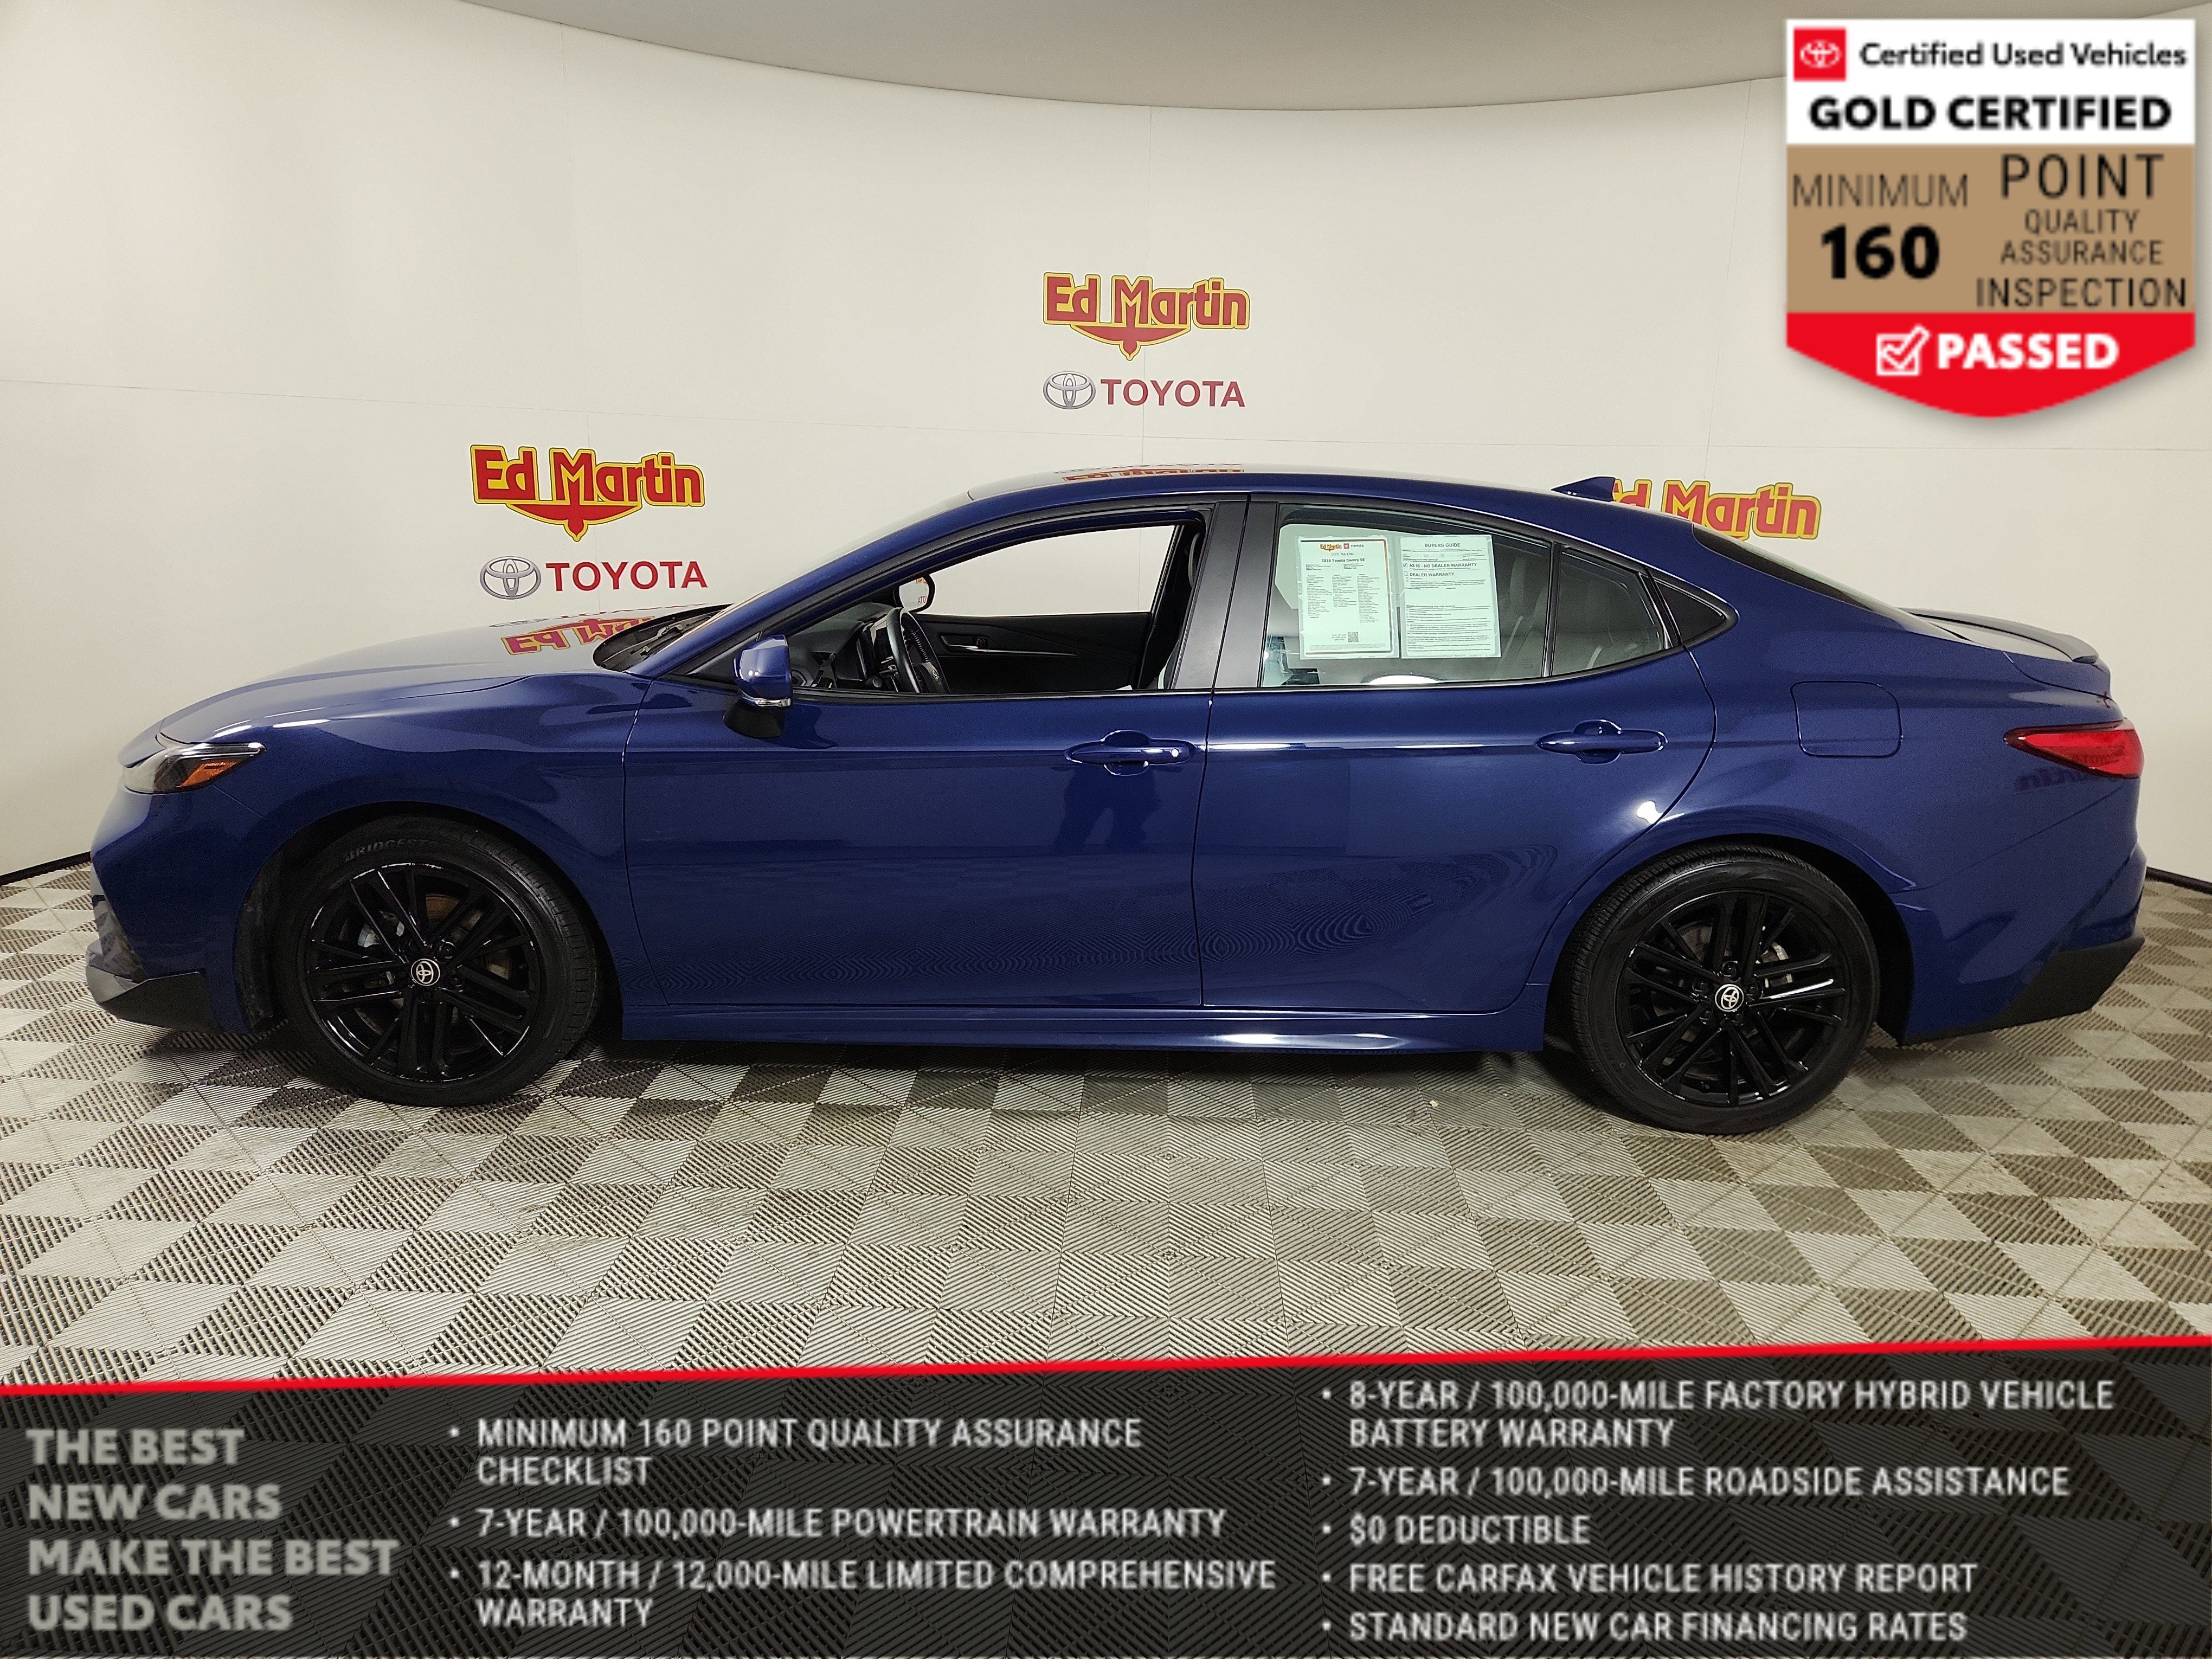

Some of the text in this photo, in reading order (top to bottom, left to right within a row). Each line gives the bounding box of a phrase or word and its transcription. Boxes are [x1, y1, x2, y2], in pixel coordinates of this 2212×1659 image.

[1044, 273, 1250, 329] Ed Martin
[1101, 378, 1245, 407] TOYOTA
[471, 445, 704, 506] Ed Martin
[1662, 480, 1821, 538] Martin
[545, 561, 708, 591] TOYOTA
